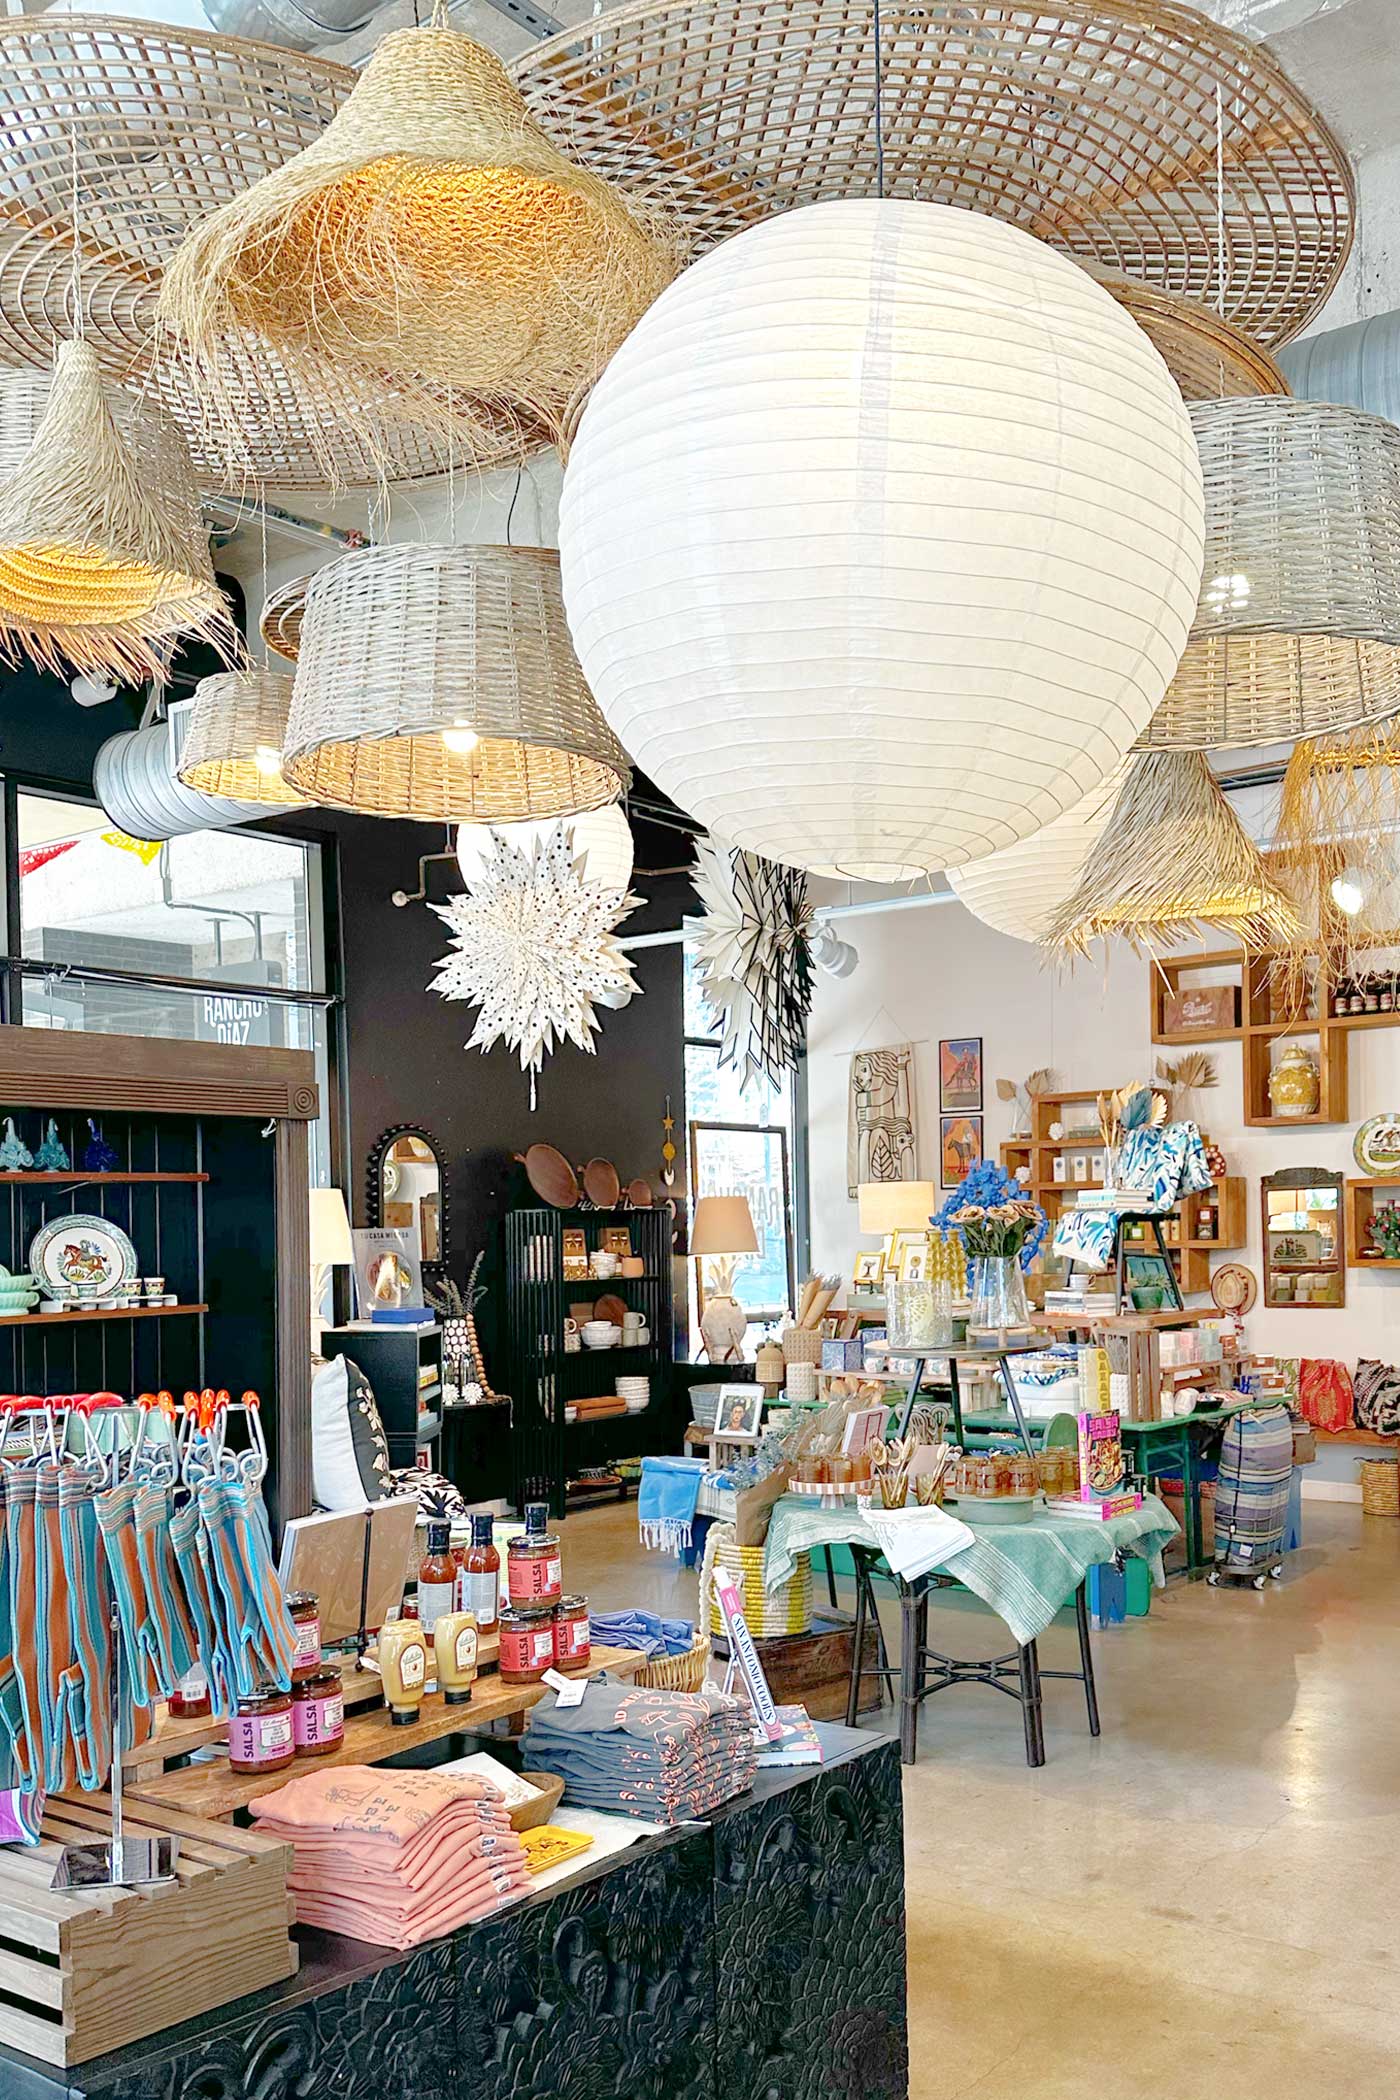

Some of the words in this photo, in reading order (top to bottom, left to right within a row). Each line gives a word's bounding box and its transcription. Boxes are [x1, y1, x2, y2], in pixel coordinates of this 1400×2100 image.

[1089, 1415, 1119, 1433] SALSA
[532, 1563, 543, 1594] SALSA
[519, 1636, 530, 1668] SALSA
[559, 1625, 569, 1656] SALSA
[733, 1618, 747, 1640] SAN
[740, 1638, 763, 1686] ANTONIO
[756, 1683, 775, 1720] COOKS
[306, 1704, 318, 1740] SALSA
[242, 1721, 254, 1758] SALSA
